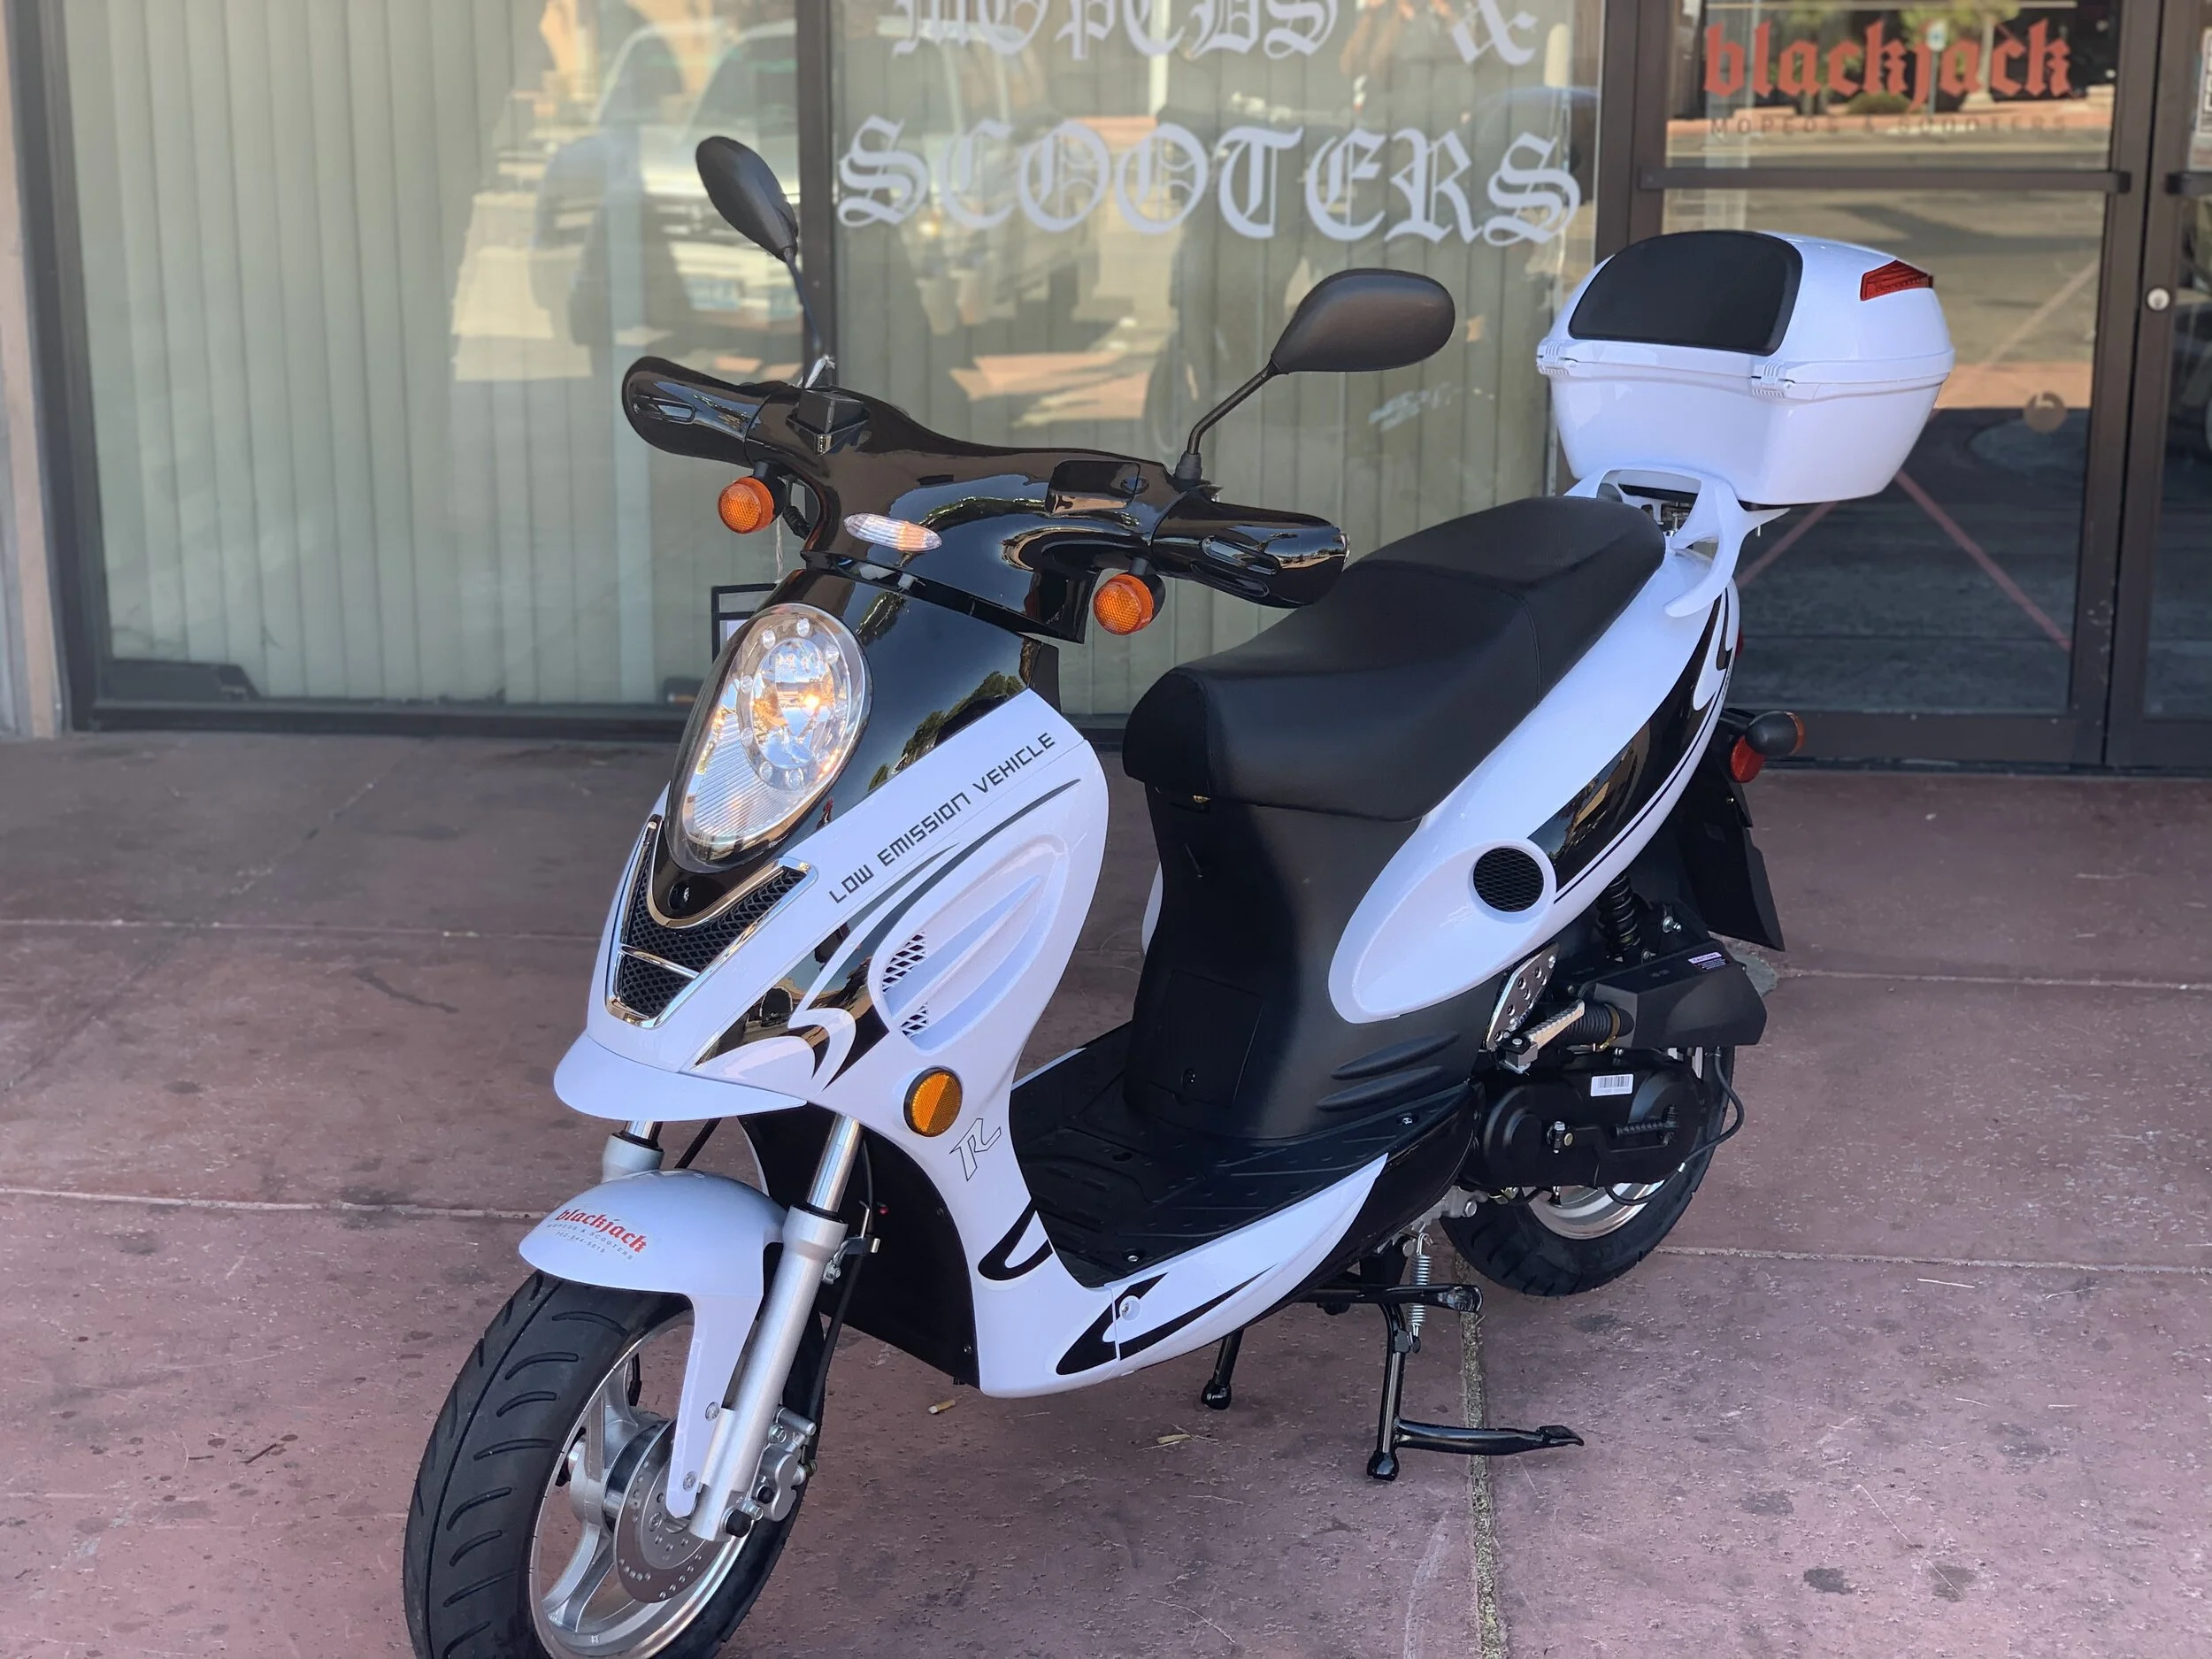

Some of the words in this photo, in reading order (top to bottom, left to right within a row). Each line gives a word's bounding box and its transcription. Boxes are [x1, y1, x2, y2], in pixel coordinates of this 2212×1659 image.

[1704, 18, 2072, 112] blackjack
[837, 115, 1581, 247] SCOOTERS
[829, 864, 874, 904] LOW
[877, 792, 972, 867] EMISSION
[973, 733, 1056, 794] VEHICLE
[555, 1209, 648, 1253] blackjack
[588, 1232, 634, 1260] SCOOTERS
